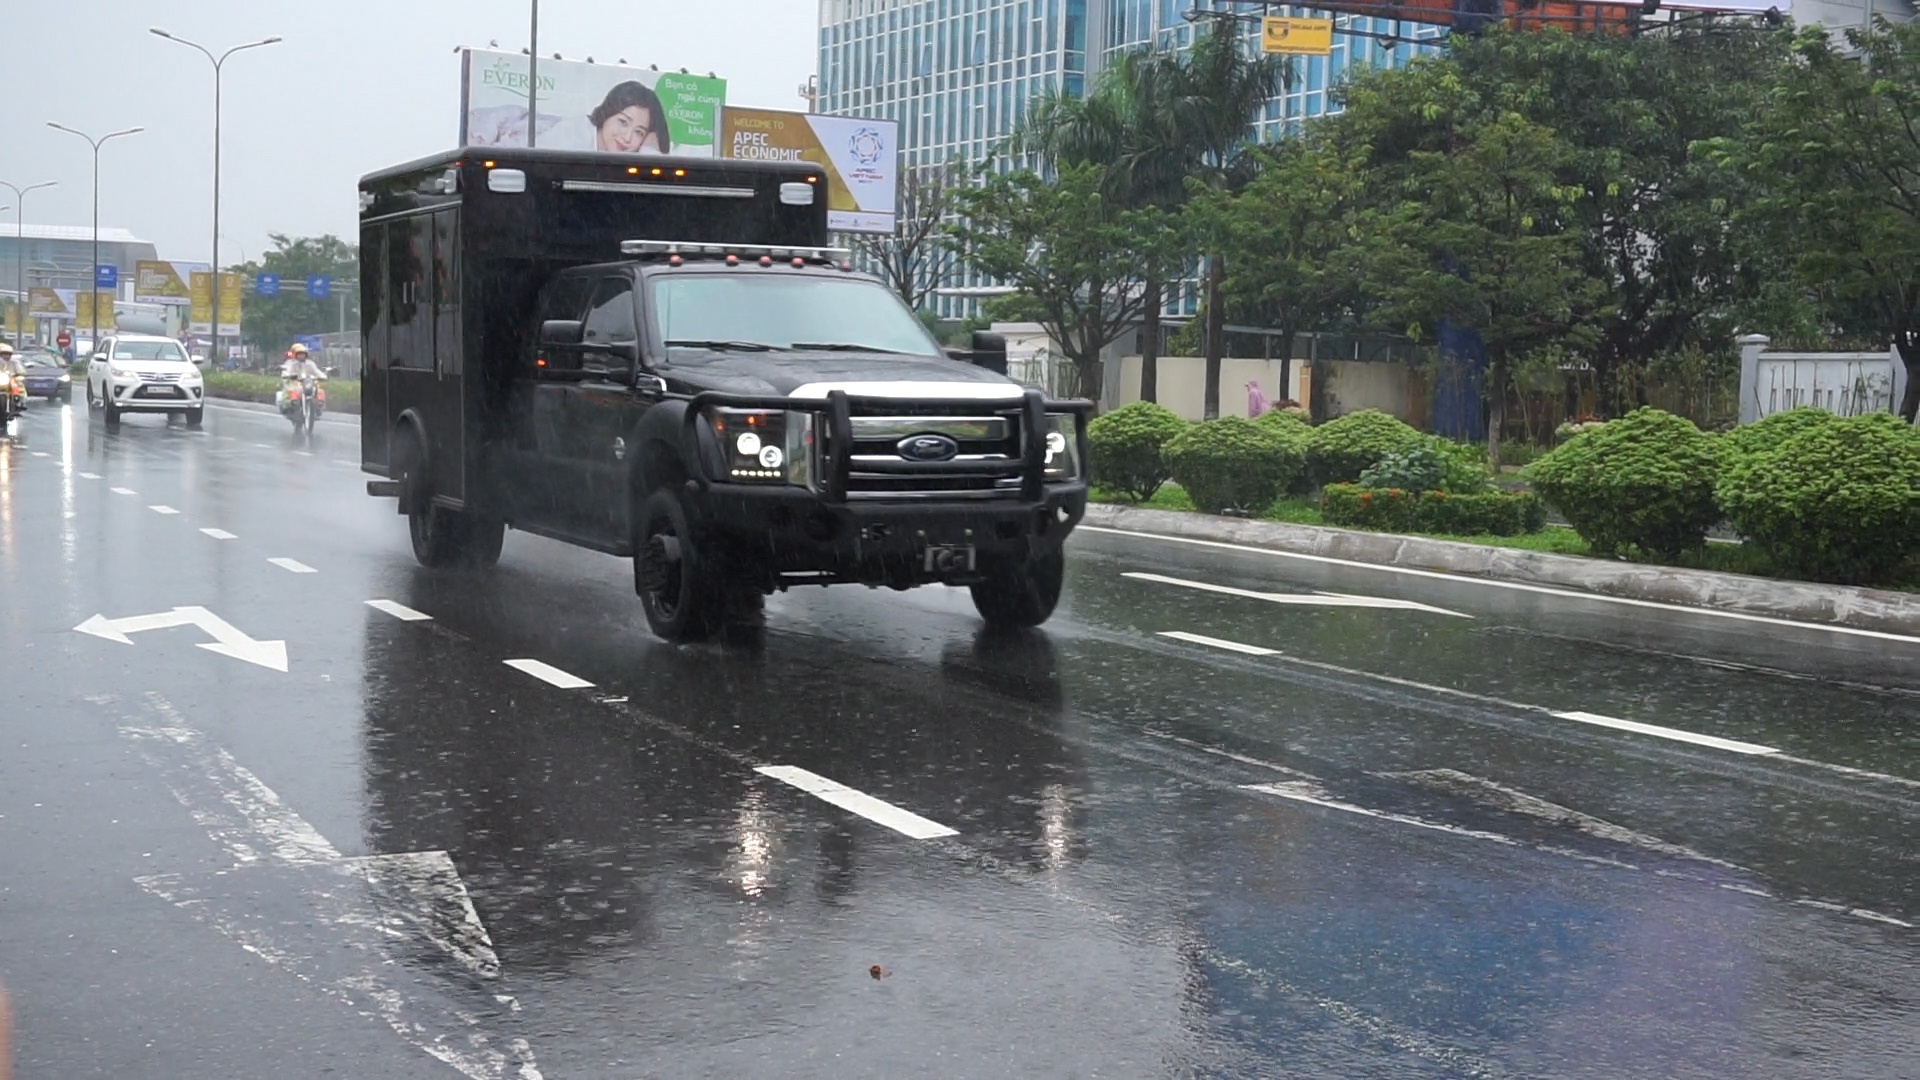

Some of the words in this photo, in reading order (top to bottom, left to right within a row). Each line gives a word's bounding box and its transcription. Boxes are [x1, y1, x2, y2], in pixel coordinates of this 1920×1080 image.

[733, 118, 772, 129] WELCOME
[774, 121, 784, 130] TO
[734, 131, 769, 146] APEC
[733, 145, 803, 161] ECONOMIC
